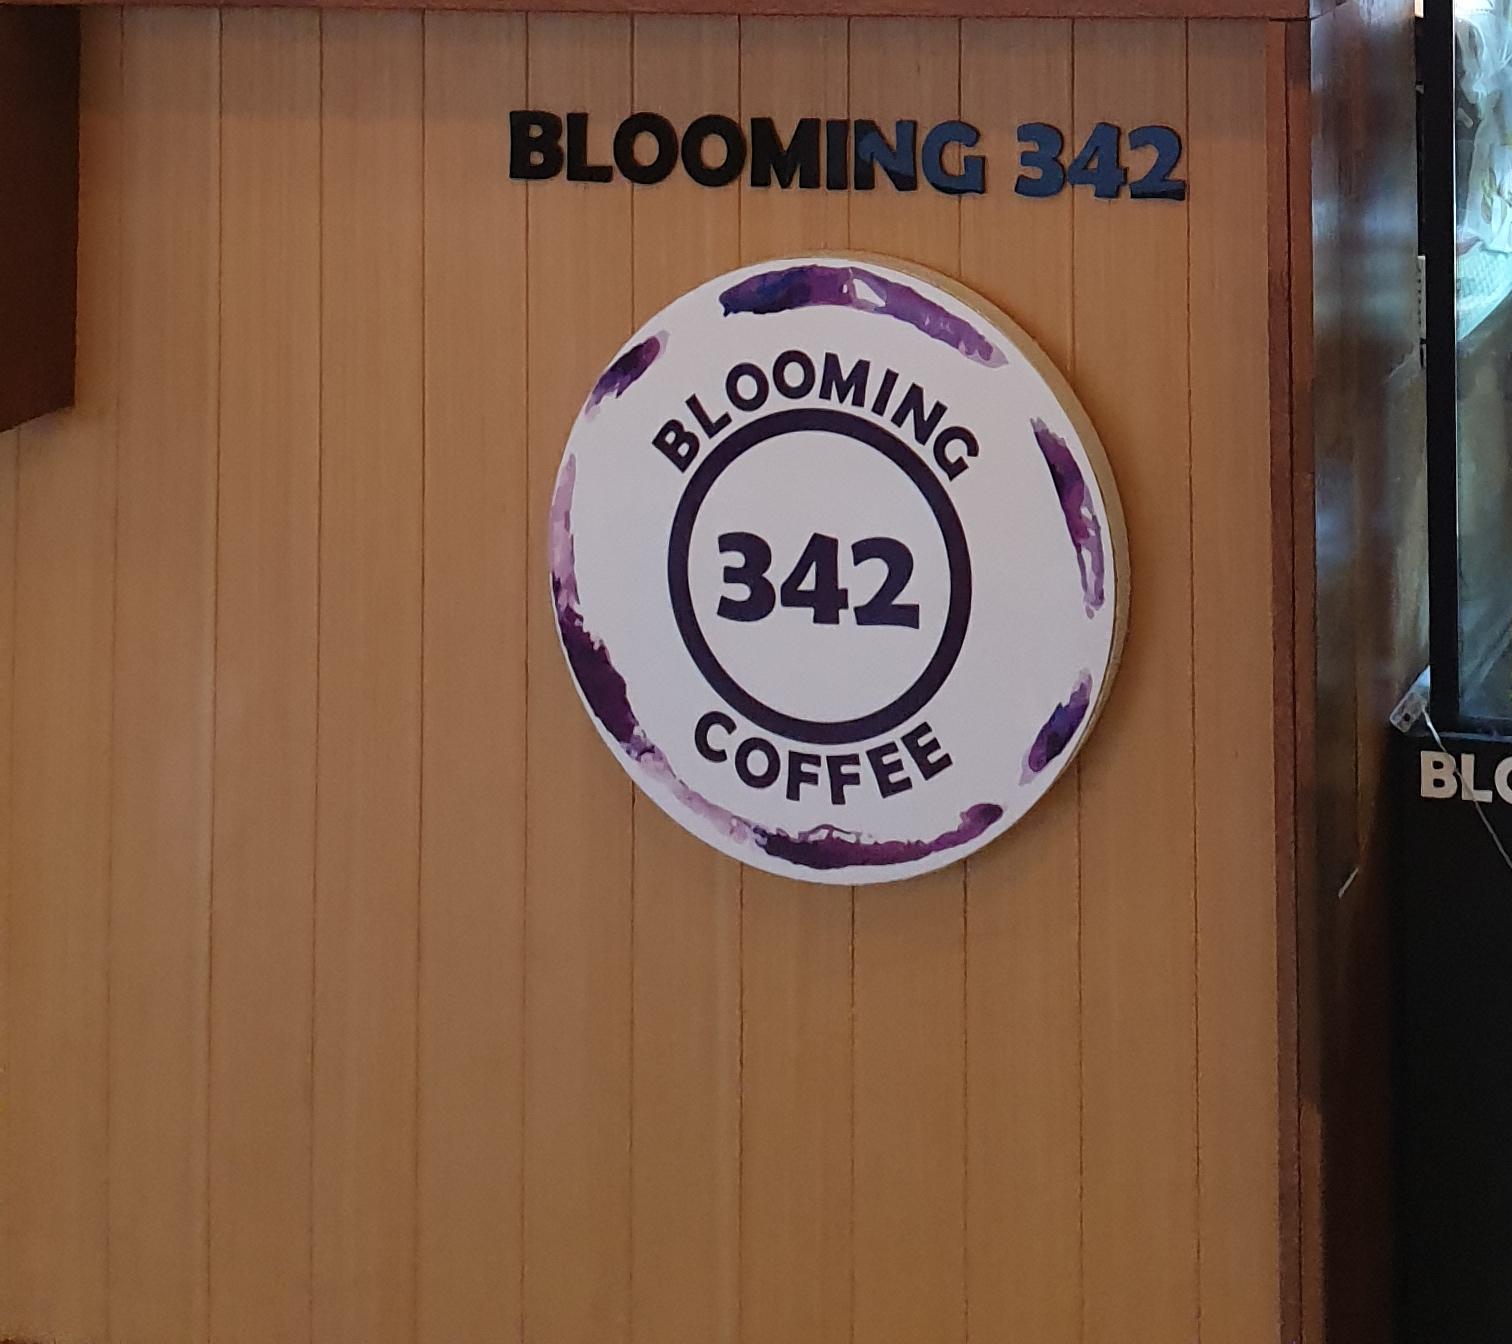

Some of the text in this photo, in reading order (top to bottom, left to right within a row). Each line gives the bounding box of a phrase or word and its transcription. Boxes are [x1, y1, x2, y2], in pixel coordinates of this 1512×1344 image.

[508, 111, 1188, 201] BLOOMING 342
[651, 349, 981, 482] BLOOMING
[715, 531, 921, 630] 342
[693, 709, 953, 806] COFFEE
